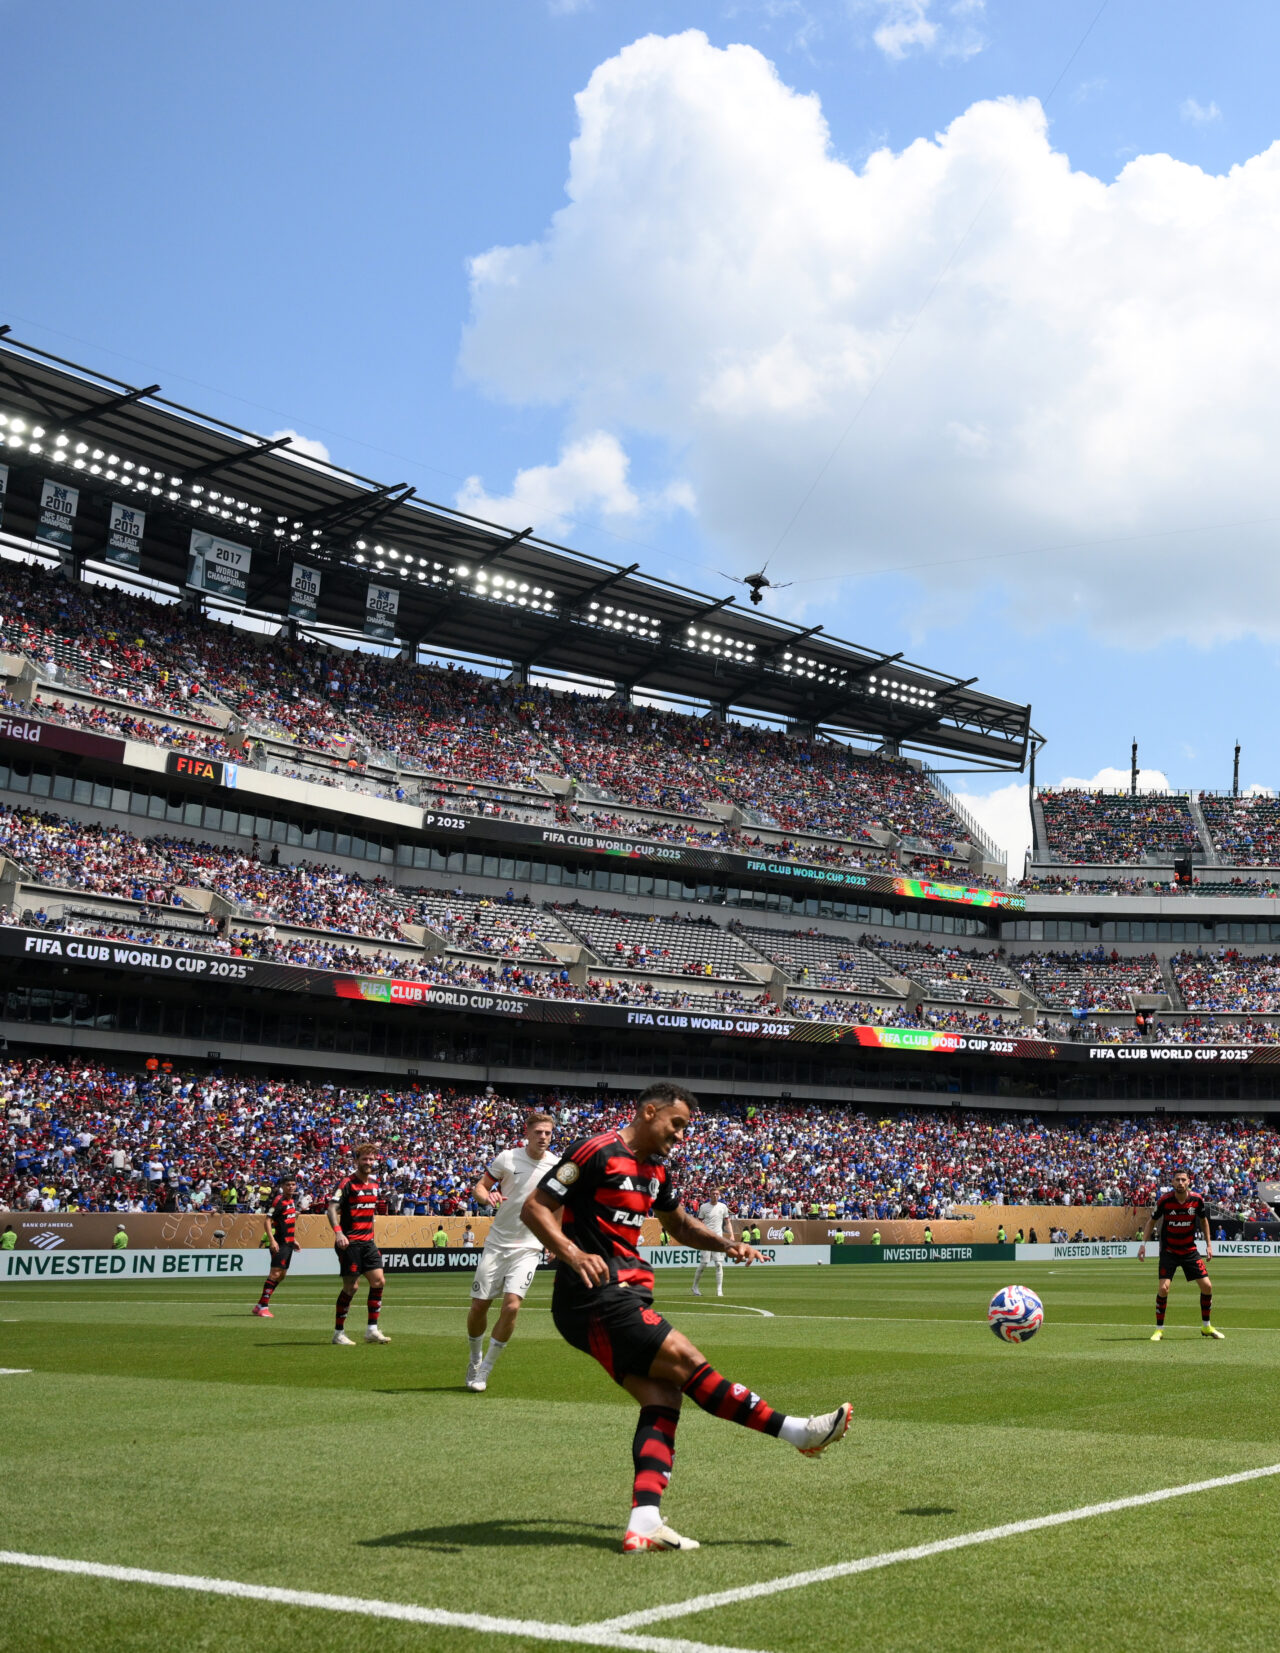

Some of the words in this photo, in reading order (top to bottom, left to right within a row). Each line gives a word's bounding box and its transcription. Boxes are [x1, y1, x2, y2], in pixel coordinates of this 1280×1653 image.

[46, 496, 72, 514] 2010
[41, 516, 72, 531] CHAMPIONS
[114, 518, 140, 536] 2013
[110, 540, 140, 552] CHAMPIONS
[216, 548, 242, 565] 2017
[207, 571, 246, 588] CHAMPIONS
[215, 565, 239, 578] WORLD
[295, 577, 317, 594] 2019
[292, 596, 317, 609] CHAMPIONS
[370, 598, 395, 614] 2022
[366, 615, 395, 628] CHAMPIONS
[177, 757, 214, 779] FIFA
[543, 832, 565, 843] FIFA
[567, 836, 593, 847] CLUB
[596, 839, 632, 852] WORLD
[635, 844, 655, 855] CUP
[747, 861, 766, 872] FIFA
[769, 864, 791, 875] CLUB
[793, 867, 825, 880] WORLD
[827, 872, 844, 882] CUP
[25, 937, 62, 955] FIFA
[66, 943, 109, 960] CLUB
[114, 949, 172, 969] WORLD
[175, 957, 207, 973] CUP
[361, 982, 387, 997] FIFA
[391, 986, 422, 1000] CLUB
[425, 989, 468, 1006] WORLD
[470, 996, 494, 1009] CUP
[627, 1012, 654, 1025] FIFA
[656, 1015, 688, 1028] CLUB
[690, 1017, 734, 1031] WORLD
[735, 1021, 760, 1033] CUP
[879, 1032, 900, 1044] FIFA
[902, 1034, 929, 1046] CLUB
[931, 1037, 966, 1049] WORLD
[968, 1040, 988, 1050] CUP
[1090, 1048, 1115, 1059] FIFA
[1117, 1049, 1148, 1059] CLUB
[1150, 1049, 1193, 1060] WORLD
[1194, 1049, 1218, 1060] CUP
[884, 1248, 927, 1260] INVESTED
[930, 1248, 939, 1259] IN
[941, 1248, 972, 1259] BETTER
[1055, 1246, 1090, 1257] INVESTED
[1092, 1246, 1099, 1256] IN
[1101, 1245, 1127, 1255] BETTER
[1218, 1244, 1270, 1253] INVESTED
[7, 1255, 125, 1275] INVESTED
[132, 1255, 155, 1273] IN
[163, 1254, 243, 1273] BETTER
[382, 1254, 409, 1267] FIFA
[412, 1253, 445, 1267] CLUB
[651, 1250, 702, 1264] INVESTE
[524, 1272, 533, 1287] 9
